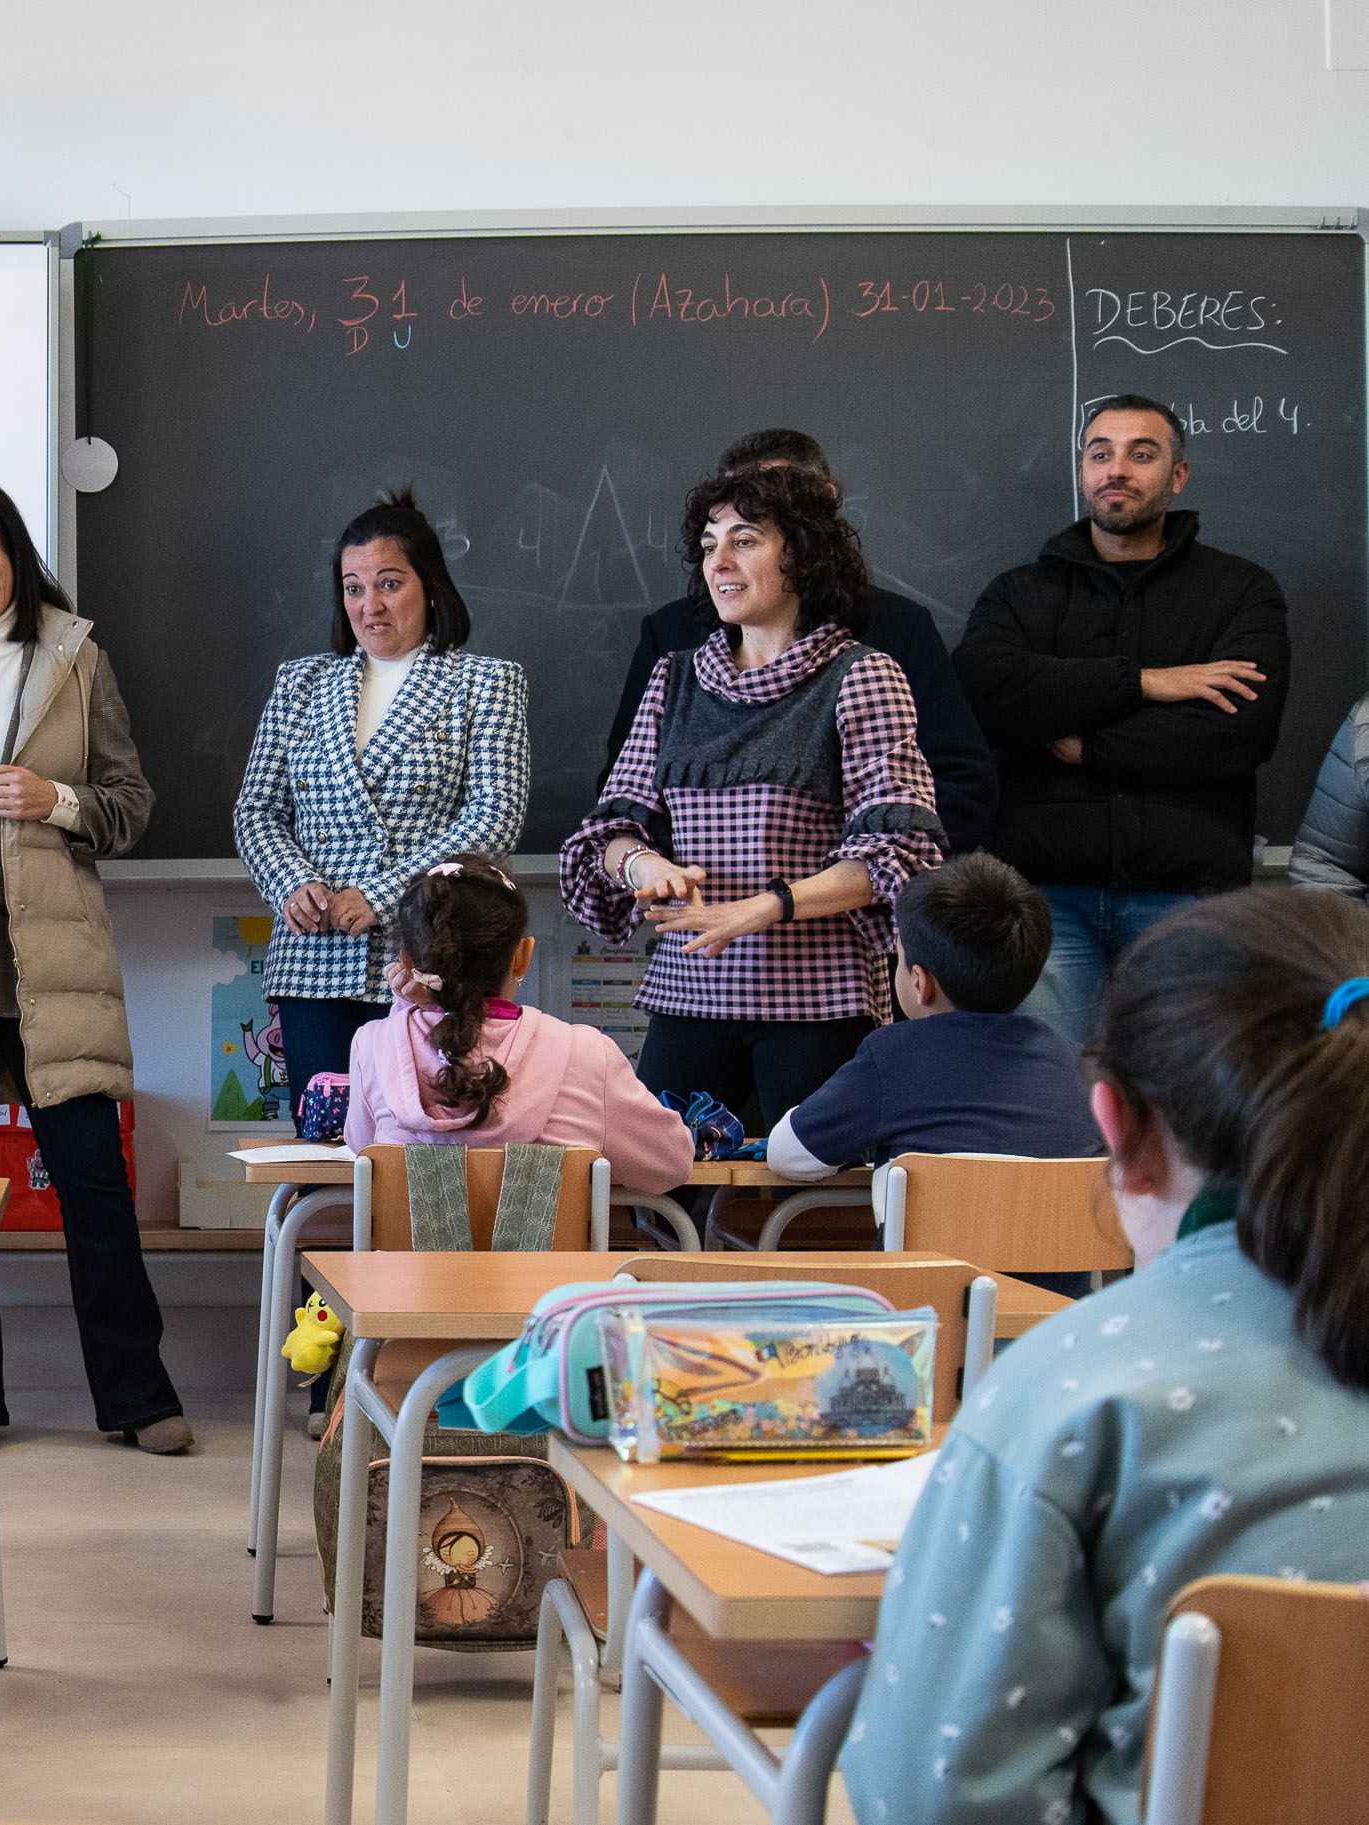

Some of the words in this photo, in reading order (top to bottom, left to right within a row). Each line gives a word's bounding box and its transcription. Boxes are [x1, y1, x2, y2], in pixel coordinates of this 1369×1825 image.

[179, 274, 317, 329] Martes,
[449, 277, 484, 318] de
[512, 292, 614, 317] enero
[631, 272, 831, 345] (Azahara)
[856, 280, 1056, 323] 31-01-2023
[1086, 288, 1283, 335] DEBERES:
[1221, 395, 1267, 435] del
